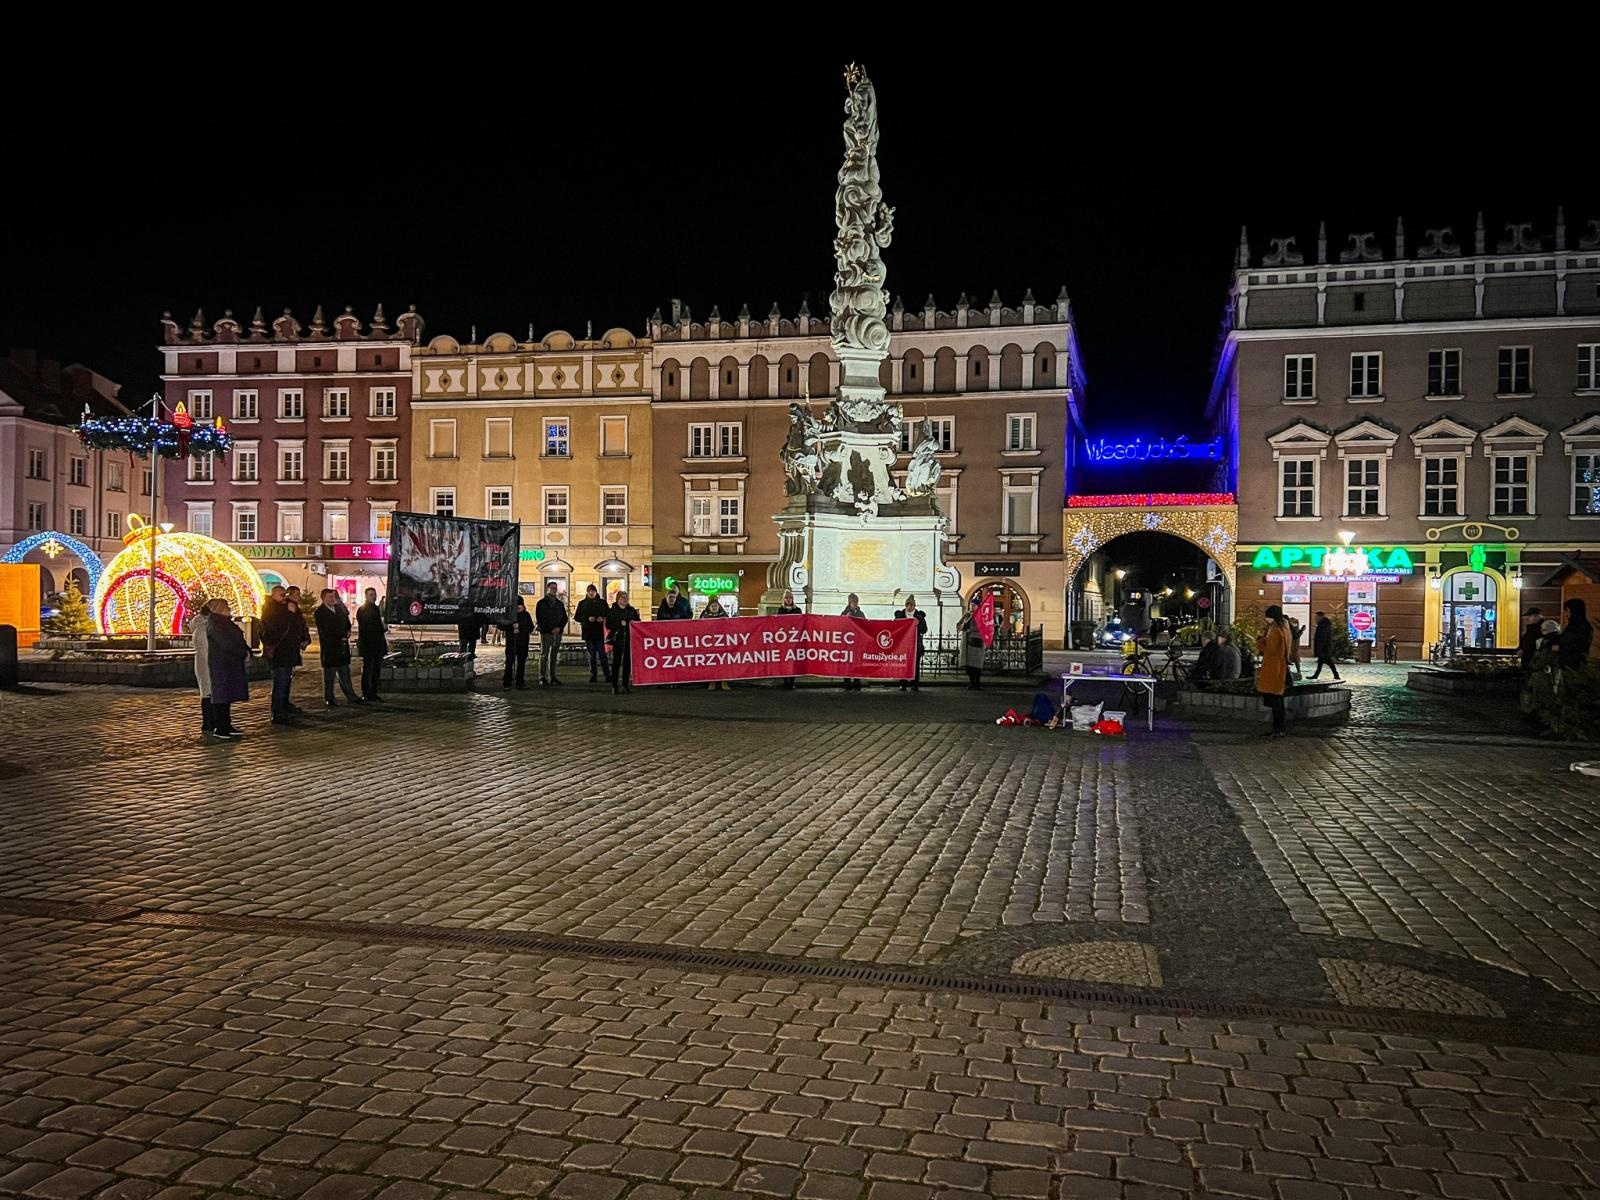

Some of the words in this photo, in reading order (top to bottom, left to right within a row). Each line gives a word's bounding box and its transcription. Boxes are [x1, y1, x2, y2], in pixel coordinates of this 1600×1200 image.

[238, 546, 295, 558] KANTOR
[1252, 547, 1413, 568] APTKA
[694, 577, 733, 589] żabka
[473, 606, 506, 614] RatujŻycie.pl
[643, 632, 751, 650] PUBLICZNY
[762, 627, 855, 644] RÓŻANIEC
[644, 656, 658, 669] O
[662, 650, 780, 668] ZATRZYMANIE
[784, 648, 853, 663] ABORCJI
[862, 651, 907, 662] RatujŻycie.pl
